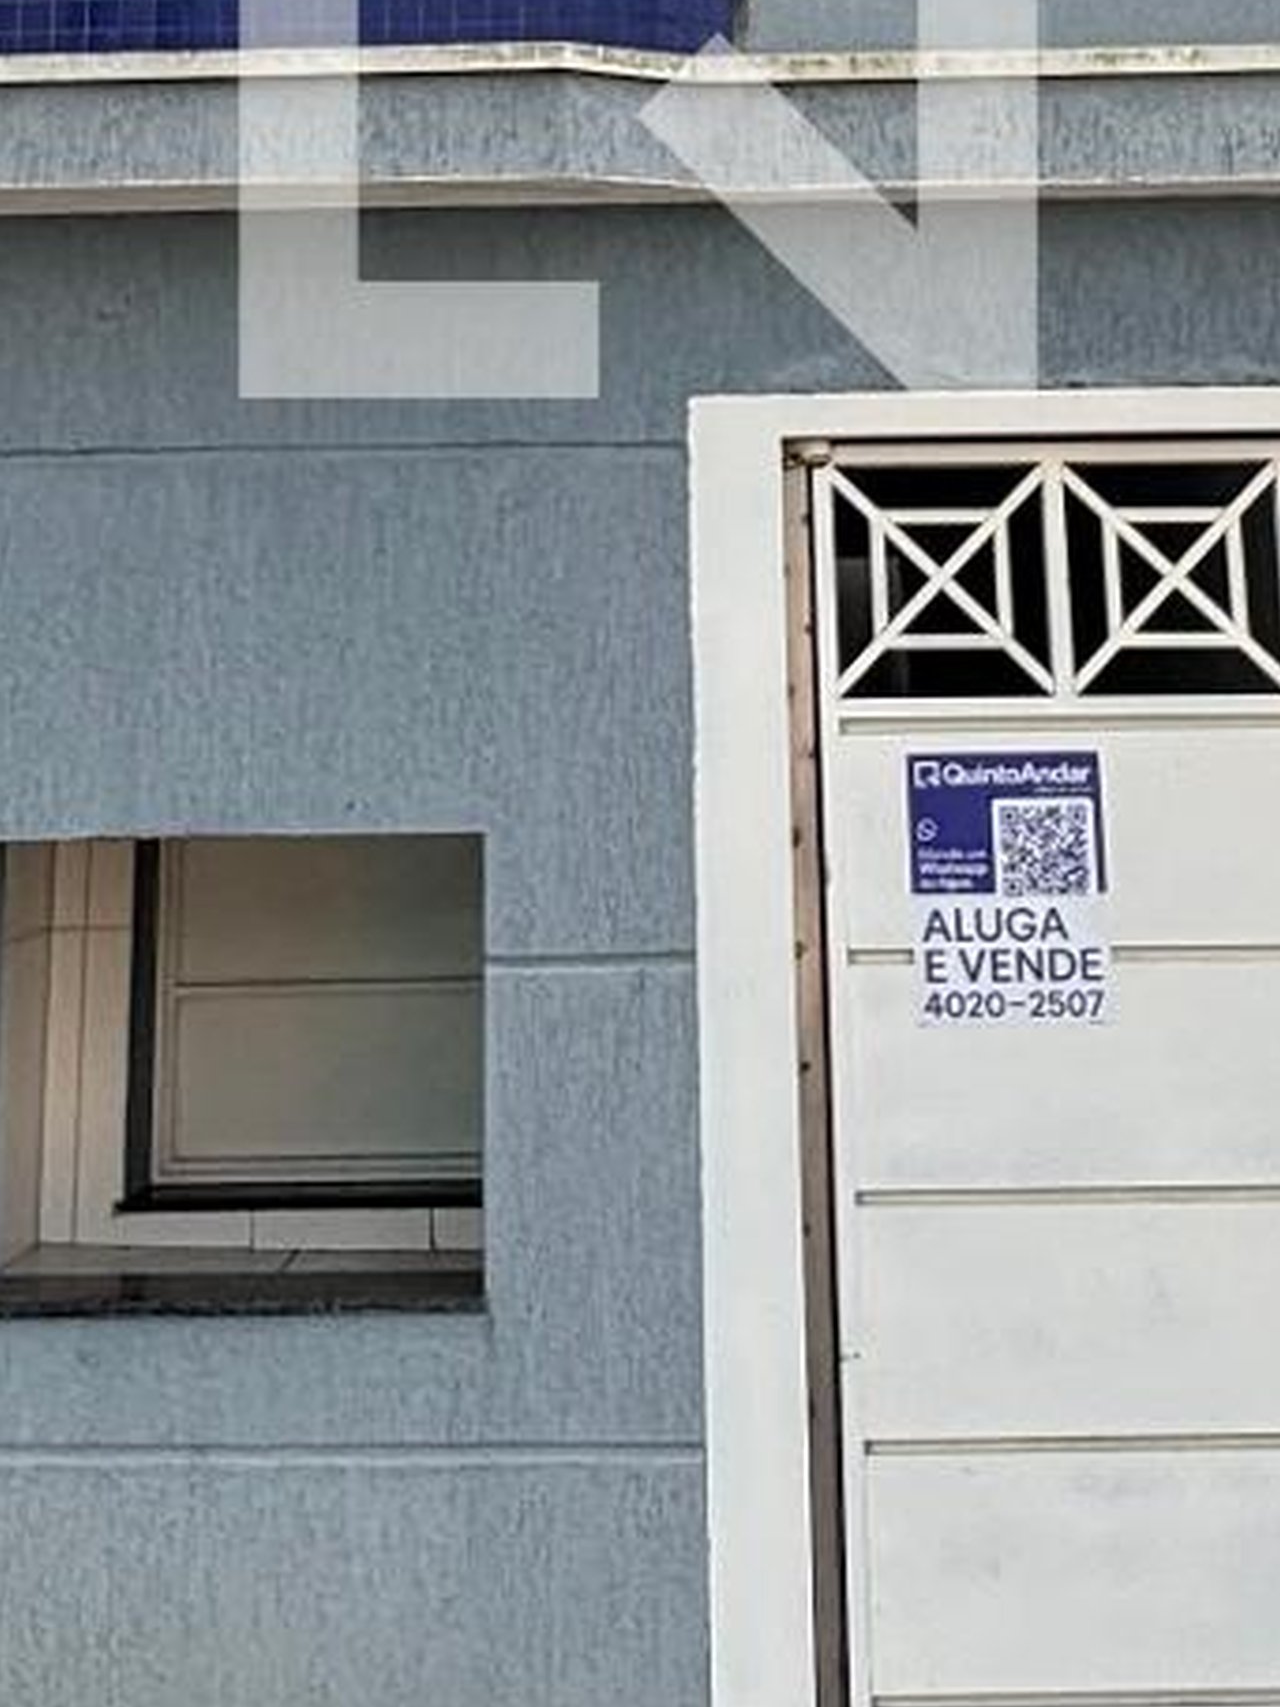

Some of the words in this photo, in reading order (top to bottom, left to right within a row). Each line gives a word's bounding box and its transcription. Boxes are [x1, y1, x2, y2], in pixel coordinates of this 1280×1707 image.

[943, 762, 1091, 787] QuintoAndar
[923, 907, 1069, 943] ALUGA
[925, 949, 948, 983] E
[958, 948, 1105, 983] VENDE
[924, 989, 1105, 1020] 4020-2507
